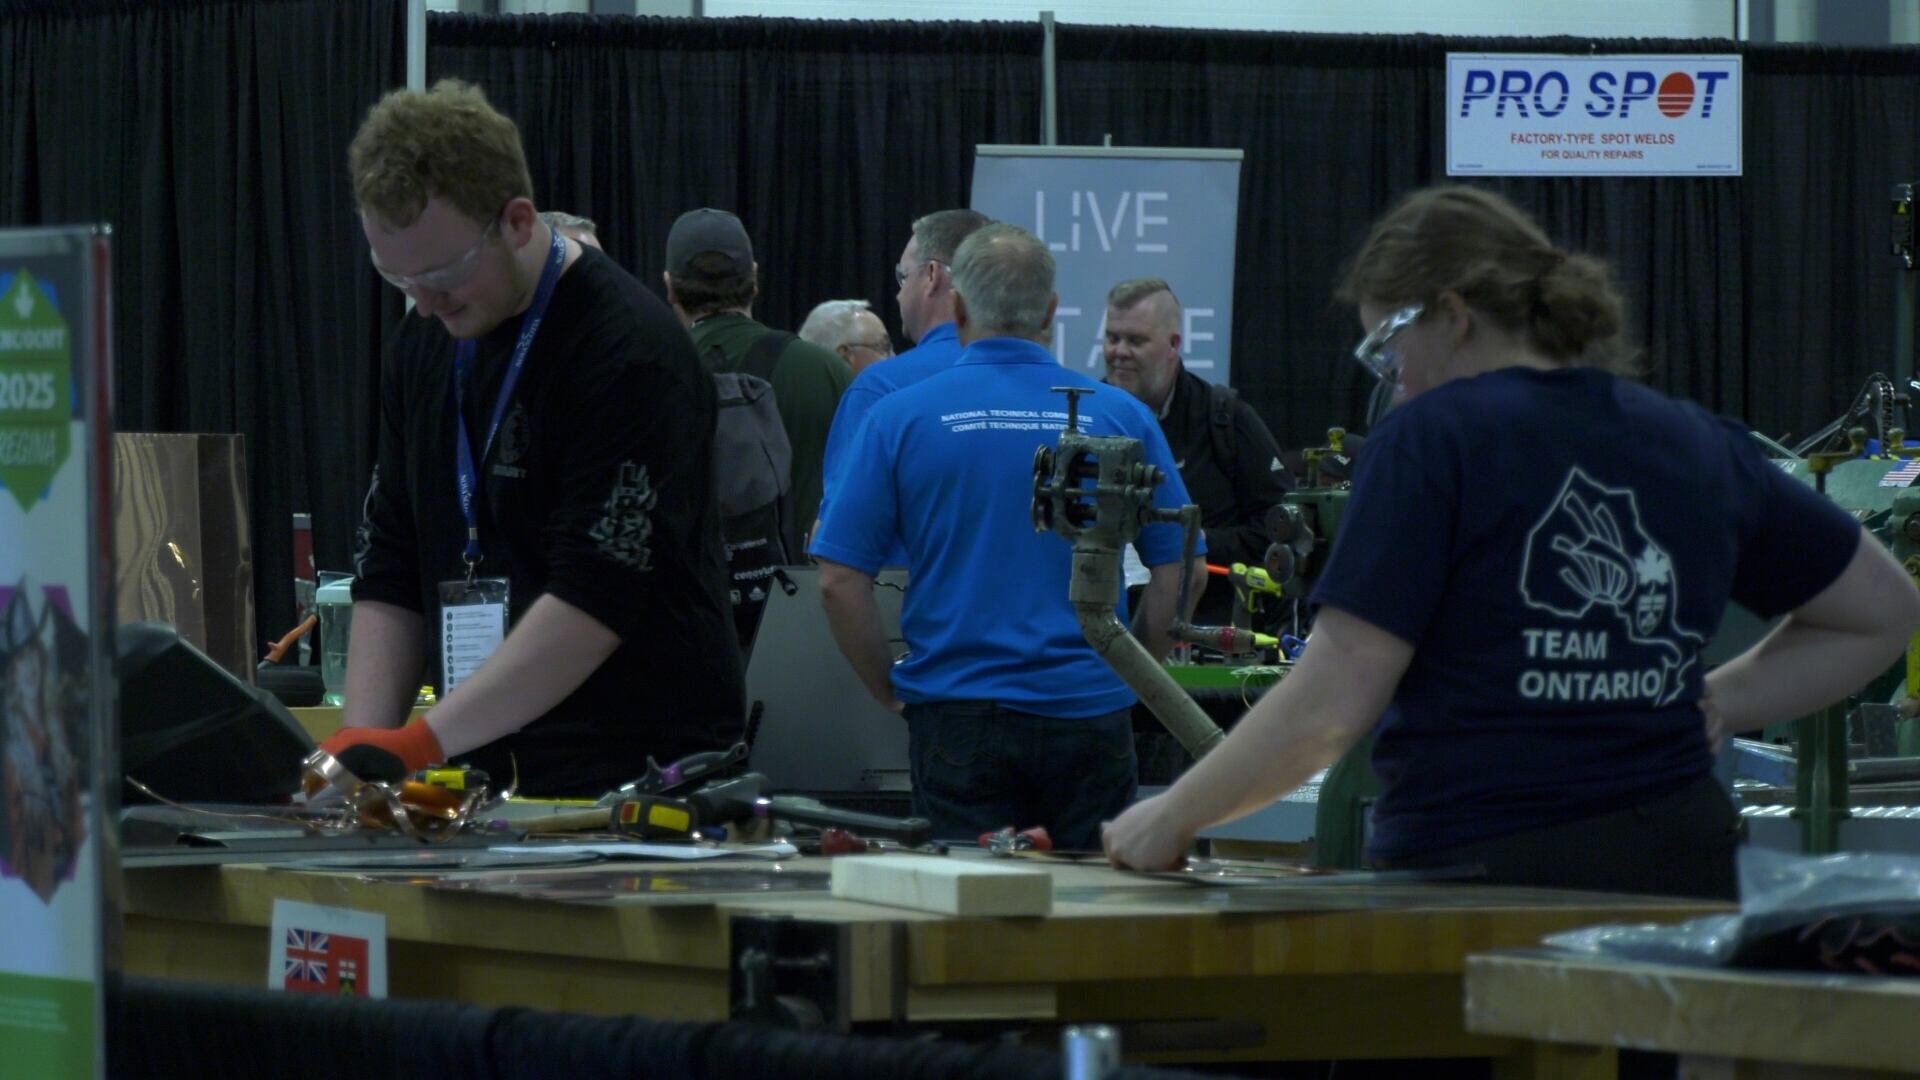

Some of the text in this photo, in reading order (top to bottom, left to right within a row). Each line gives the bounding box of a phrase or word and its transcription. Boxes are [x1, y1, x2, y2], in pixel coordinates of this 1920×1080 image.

[1460, 70, 1730, 118] PRO SPOT
[1510, 133, 1675, 145] FACTORY-TYPE SPOT WELDS
[1541, 150, 1644, 161] FOR QUALITY REPAIRS
[1036, 191, 1168, 252] LIVE
[0, 371, 55, 411] 2025
[941, 410, 988, 423] NATIONAL
[990, 409, 1040, 419] TECHNICAL
[952, 420, 987, 433] COMITÉ
[989, 421, 1040, 432] TECHNIQUE
[1523, 629, 1608, 660] TEAM
[1519, 668, 1662, 701] ONTARIO
